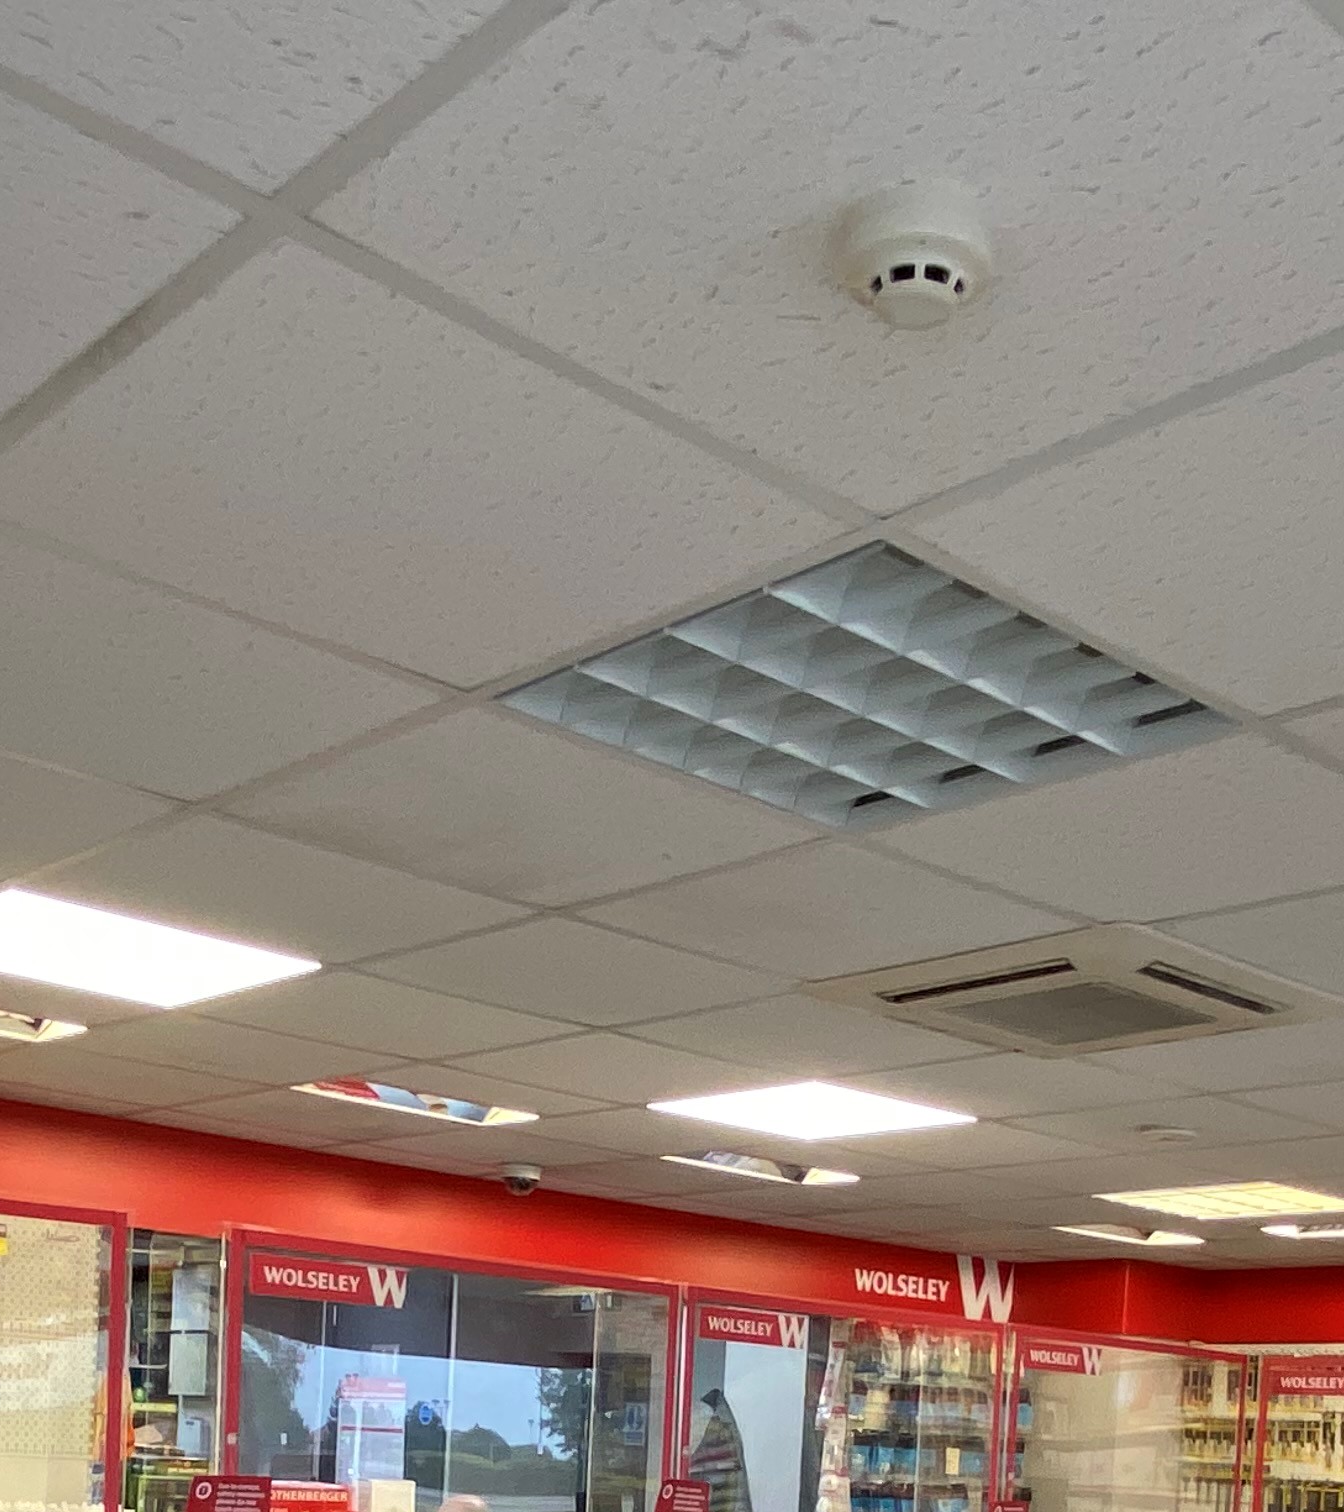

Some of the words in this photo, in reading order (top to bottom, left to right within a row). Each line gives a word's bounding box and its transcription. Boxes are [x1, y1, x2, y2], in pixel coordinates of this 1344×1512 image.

[263, 1265, 360, 1293] WOLSELEY
[367, 1266, 407, 1309] W
[855, 1268, 949, 1302] WOLSELEY
[956, 1254, 1014, 1323] W
[707, 1316, 773, 1336] WOLSELEY
[778, 1315, 807, 1349] W
[1029, 1349, 1079, 1367] WOLSELEY
[1082, 1347, 1102, 1375] W
[1280, 1376, 1344, 1390] WOLSELEY
